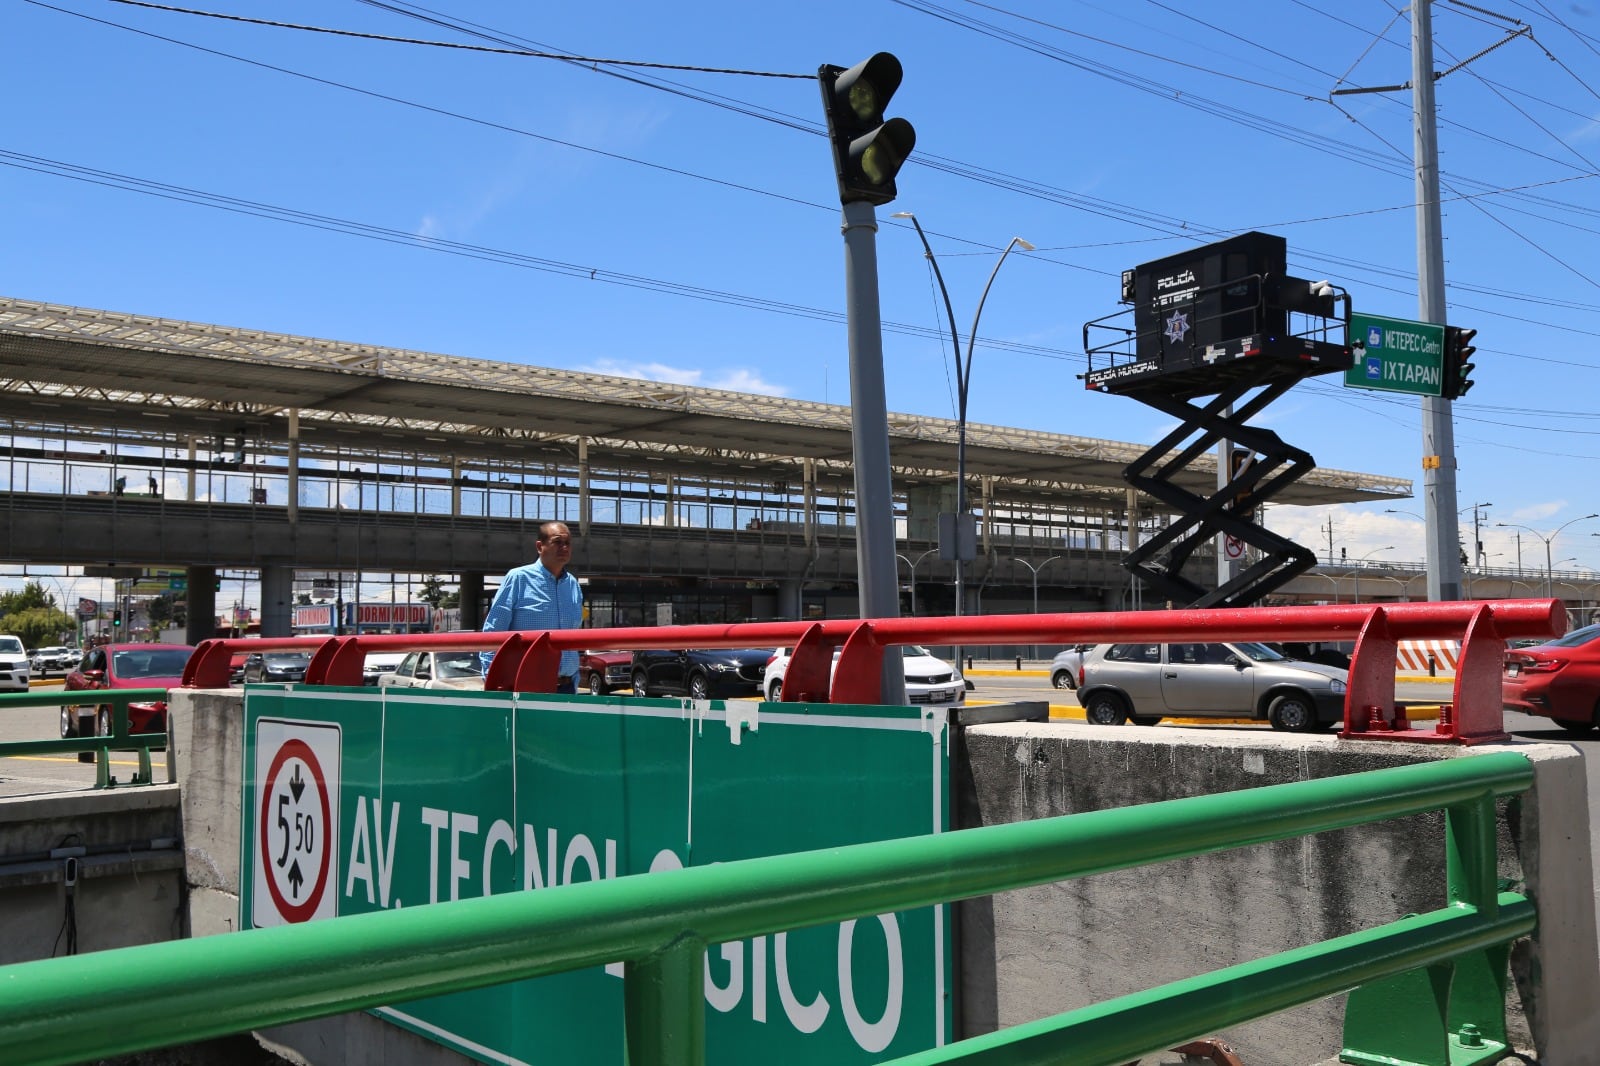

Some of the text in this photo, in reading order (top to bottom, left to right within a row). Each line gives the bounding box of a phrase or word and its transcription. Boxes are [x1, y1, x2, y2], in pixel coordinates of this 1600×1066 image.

[1385, 329, 1441, 355] METEPEC Centro
[1384, 360, 1440, 385] IXTAPAN
[346, 795, 904, 1053] AV. TECNGICO
